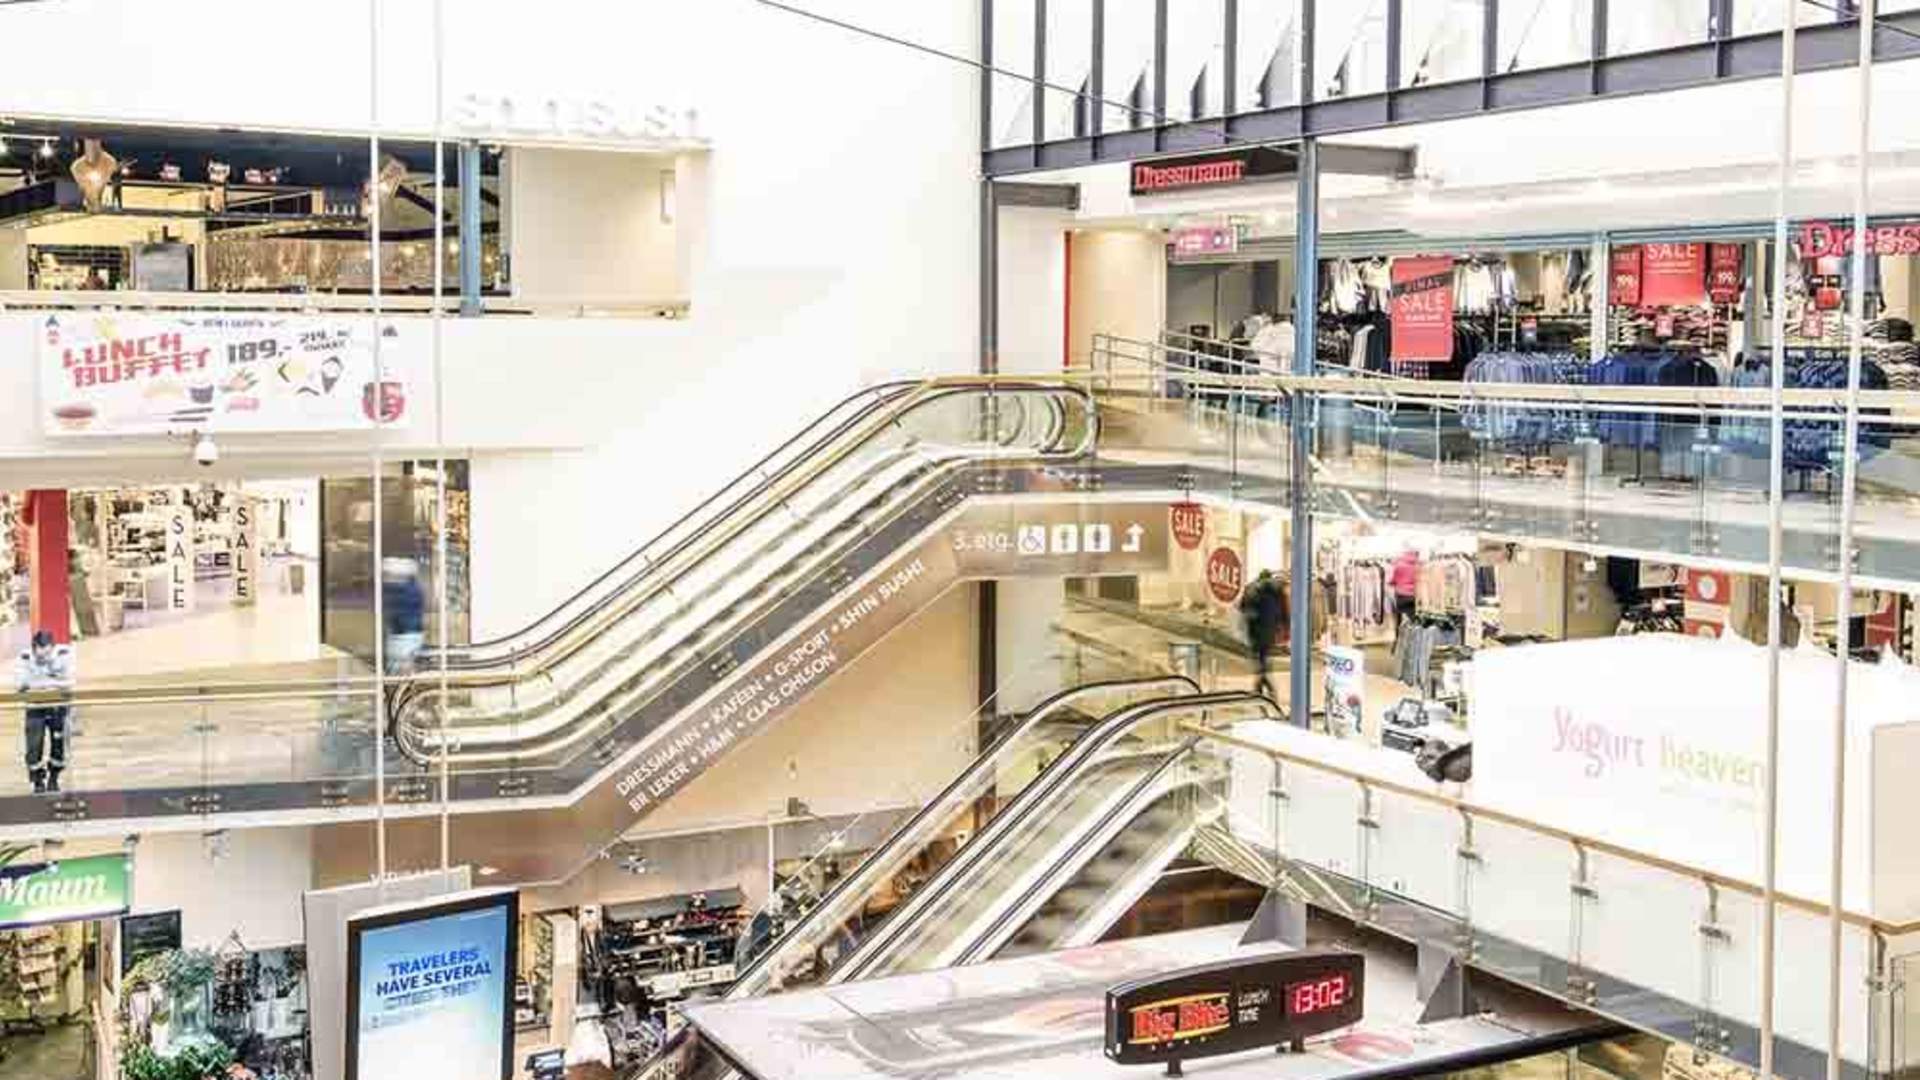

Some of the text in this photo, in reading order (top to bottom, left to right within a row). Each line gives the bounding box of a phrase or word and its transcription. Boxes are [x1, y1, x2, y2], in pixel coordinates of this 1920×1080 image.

[1135, 161, 1245, 189] Dressmann
[1647, 243, 1697, 260] SALE
[1399, 293, 1445, 313] SALE
[63, 333, 182, 368] LUNCH
[74, 347, 211, 388] BUFFET
[1174, 510, 1202, 537] SALE
[172, 515, 185, 608] SALE
[236, 506, 249, 597] SALE
[1211, 559, 1239, 590] SALE
[616, 728, 702, 797] DRESSMANN
[774, 630, 831, 677] G-SPORT
[840, 596, 880, 631] SHIN
[1552, 704, 1645, 779] Yogurt
[376, 961, 492, 997] HAVE SEVERAL
[387, 948, 480, 977] TRAVELERS
[1296, 976, 1344, 1014] 13:02
